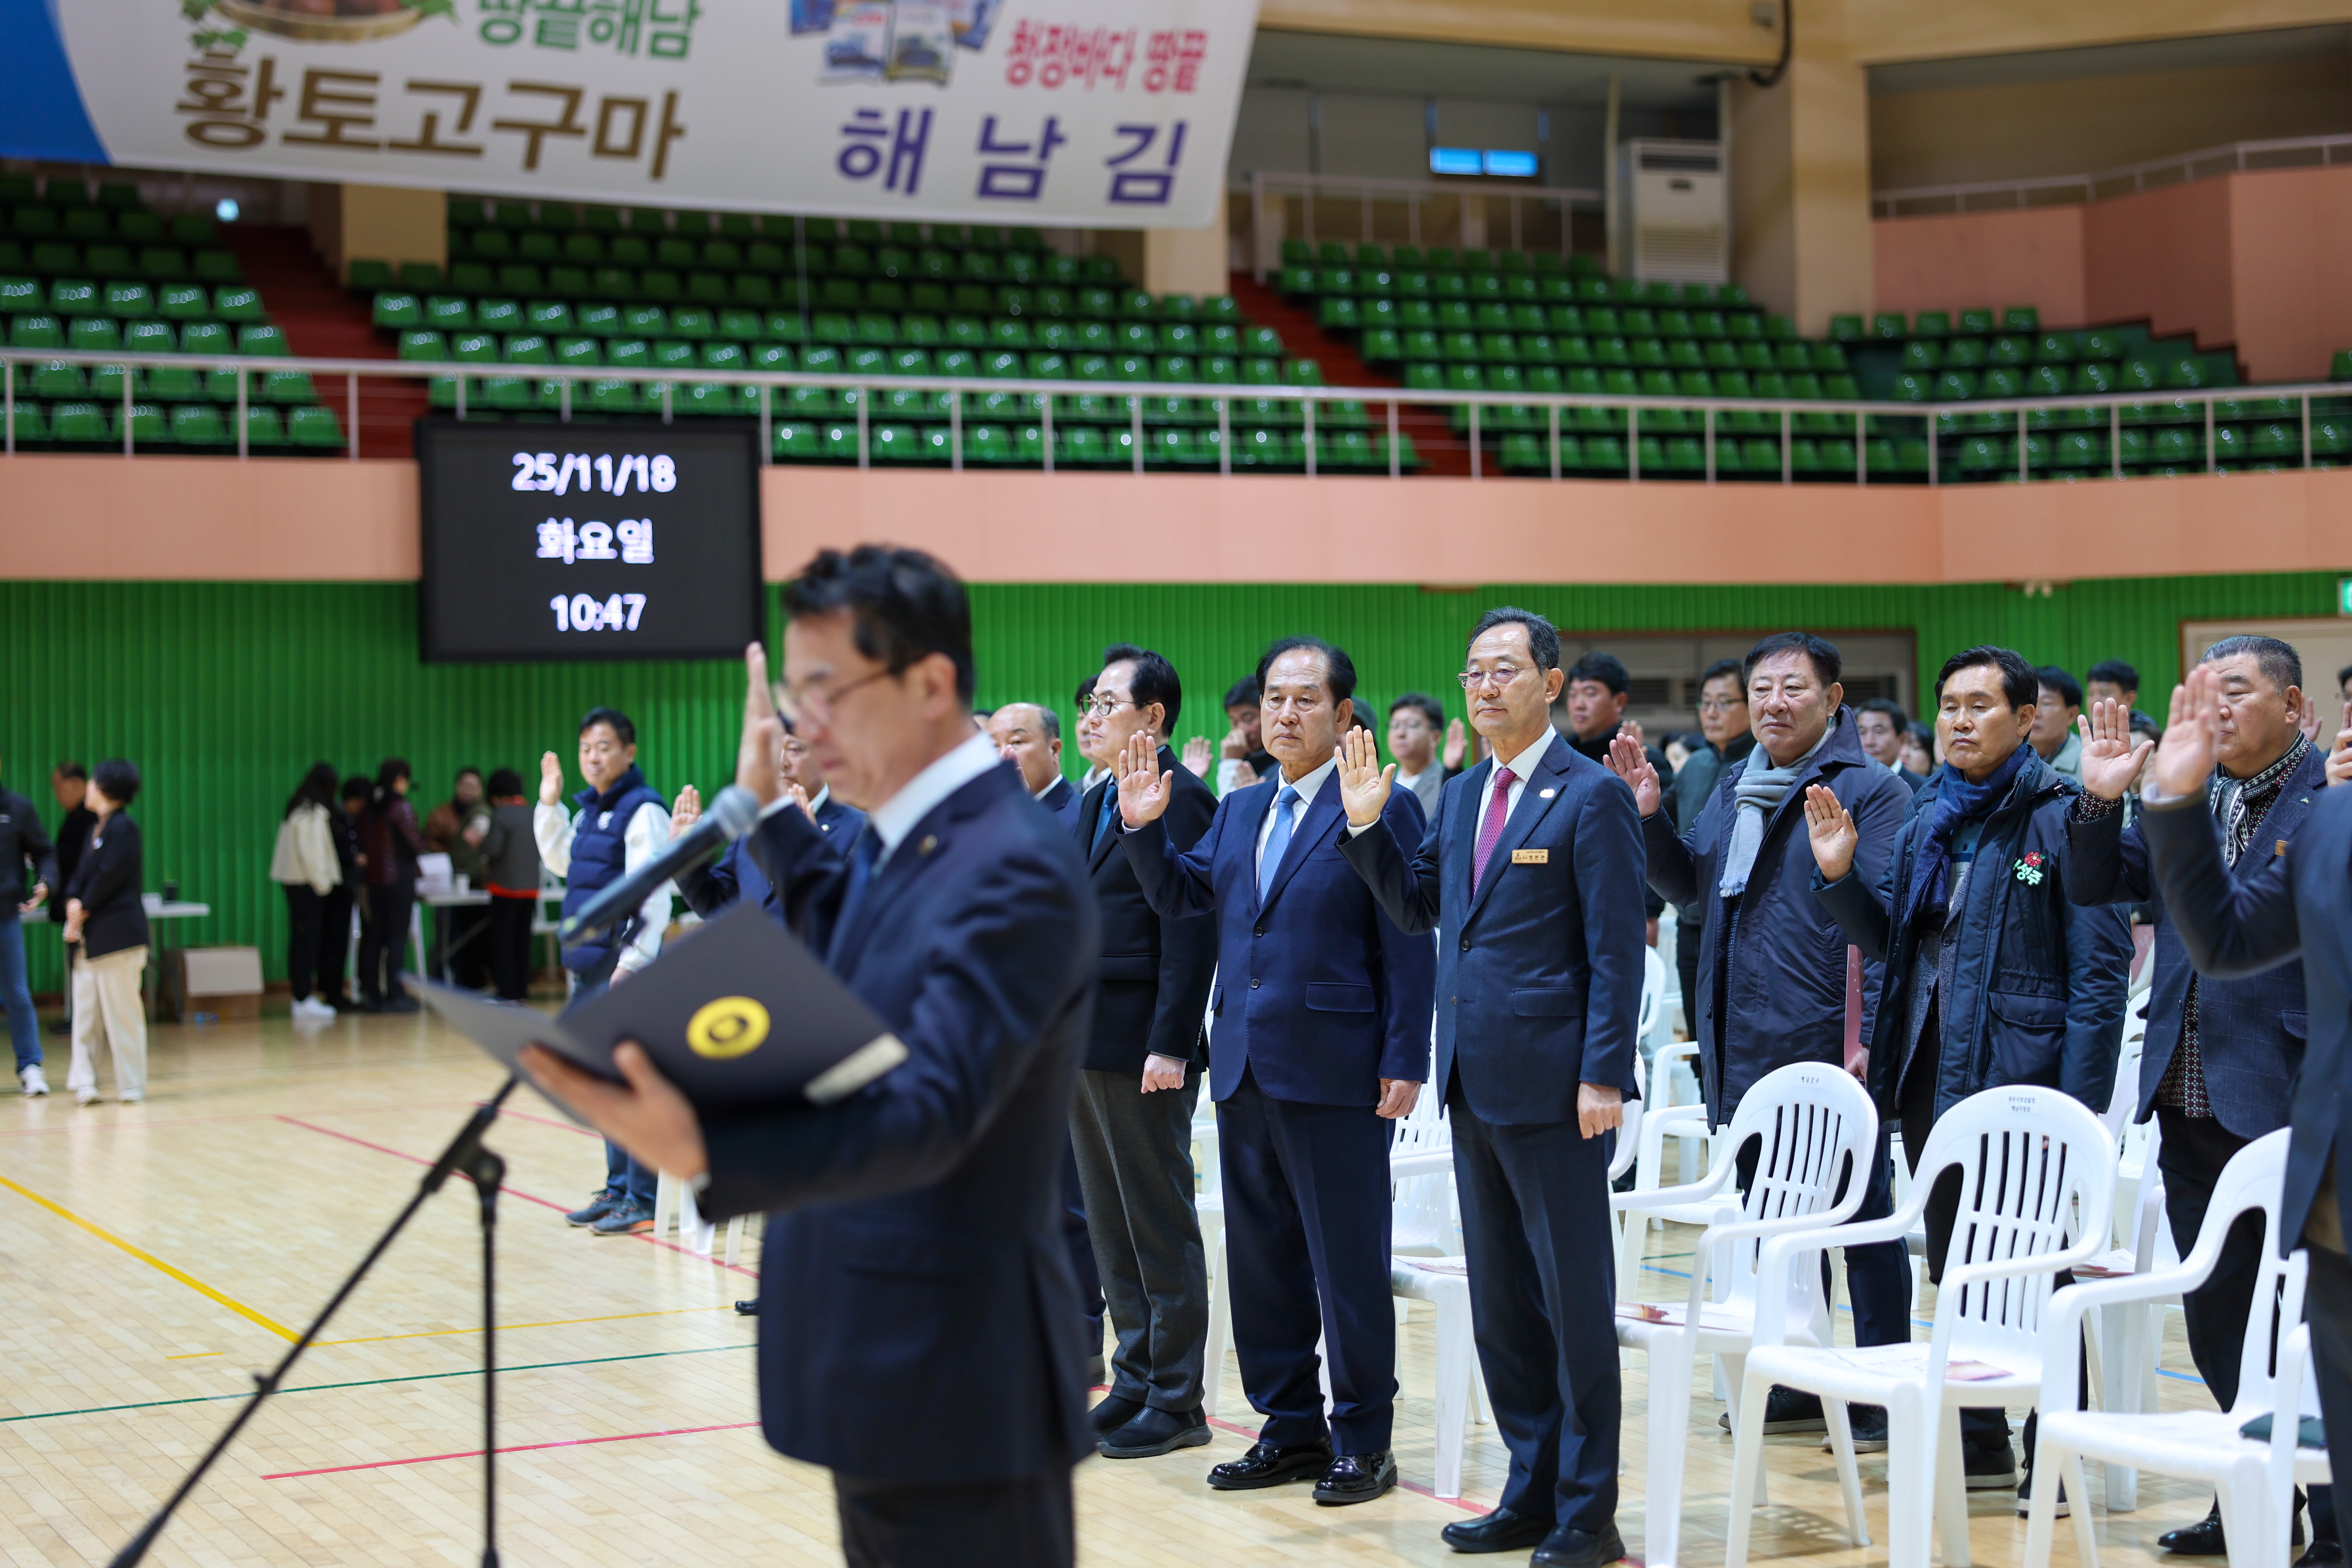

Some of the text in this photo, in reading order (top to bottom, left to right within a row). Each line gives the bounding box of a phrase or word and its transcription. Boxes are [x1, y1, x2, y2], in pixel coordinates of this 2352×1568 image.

[175, 51, 685, 181] 황토고구마
[512, 452, 677, 497] 25/11/18
[536, 517, 655, 564] 화요일
[550, 593, 647, 632] 10:47
